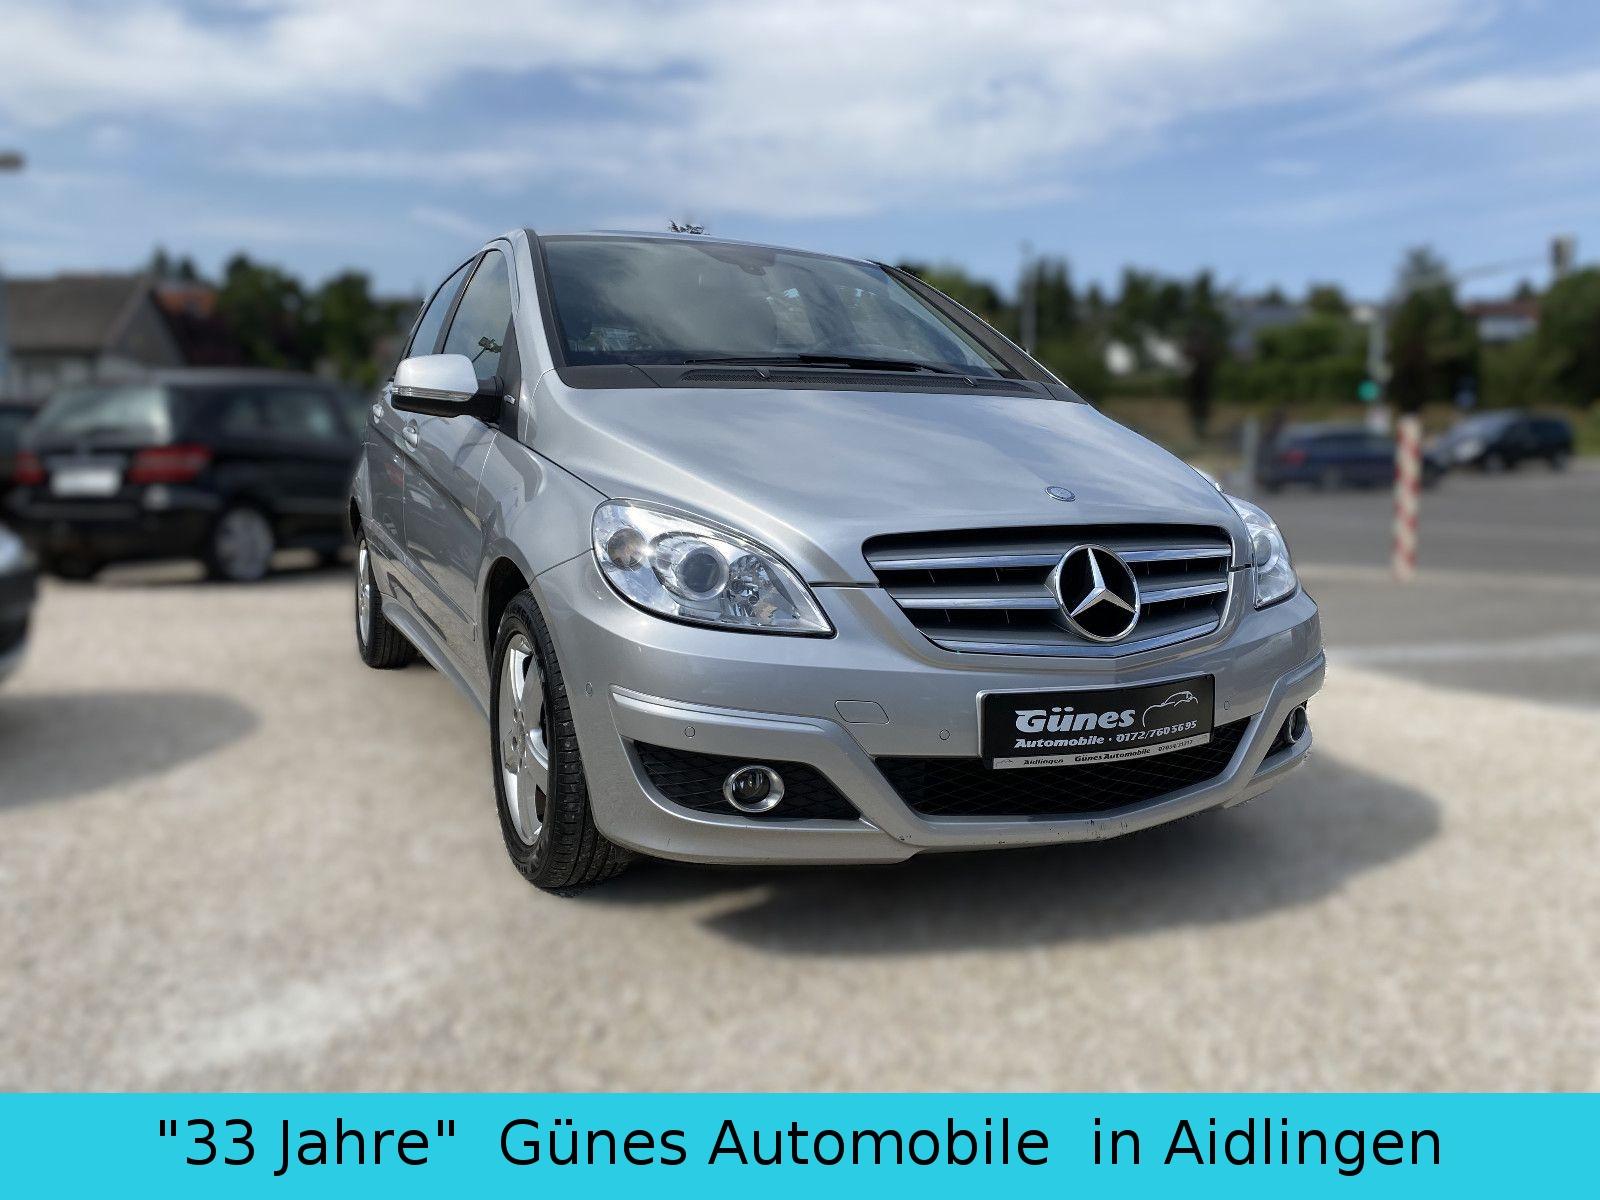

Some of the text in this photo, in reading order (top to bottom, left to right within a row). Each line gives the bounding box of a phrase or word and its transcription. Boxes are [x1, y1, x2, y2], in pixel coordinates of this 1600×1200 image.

[1014, 706, 1136, 734] Günes
[1014, 736, 1105, 749] Automobile
[1023, 758, 1064, 767] Aidlingen
[1074, 753, 1102, 763] Günes
[1103, 748, 1151, 761] Automobile
